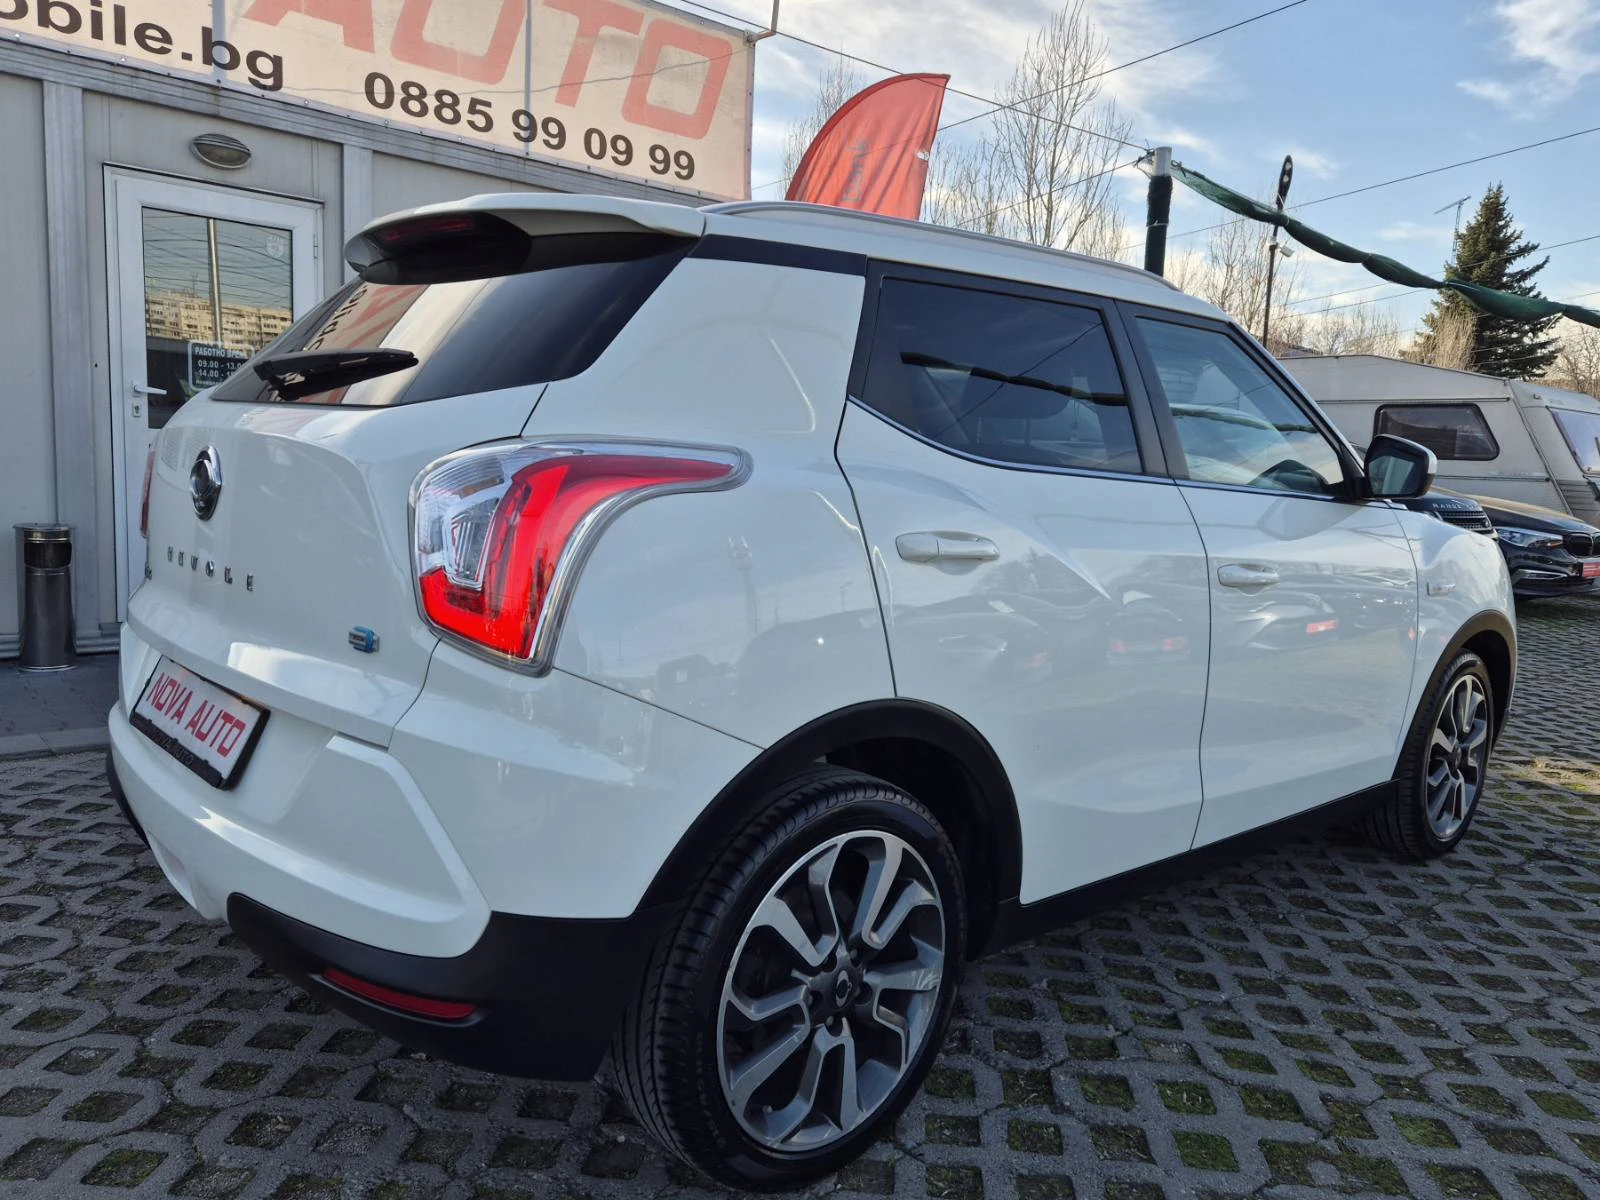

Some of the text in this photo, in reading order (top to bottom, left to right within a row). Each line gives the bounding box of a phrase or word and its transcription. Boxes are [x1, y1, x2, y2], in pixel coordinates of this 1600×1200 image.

[364, 72, 695, 180] 0885 99 09 99
[197, 360, 219, 369] 09.00
[146, 672, 246, 757] NOVA AUTO
